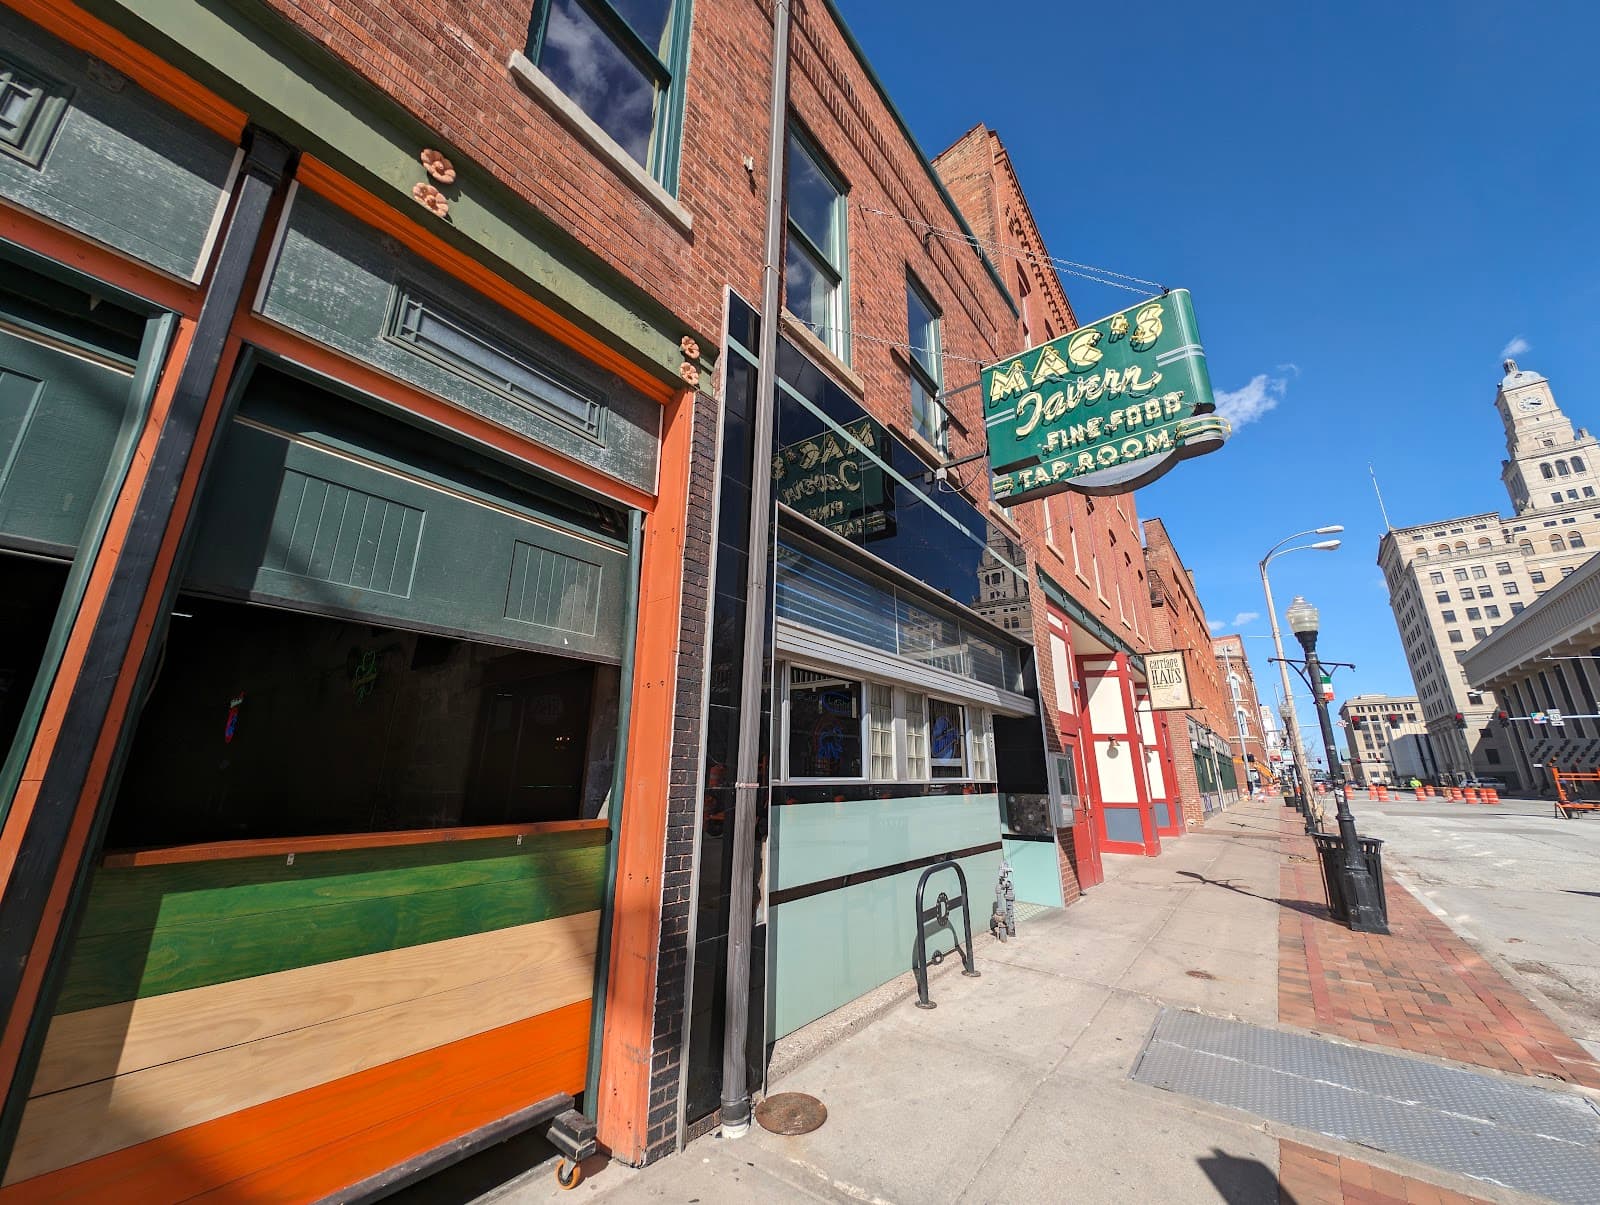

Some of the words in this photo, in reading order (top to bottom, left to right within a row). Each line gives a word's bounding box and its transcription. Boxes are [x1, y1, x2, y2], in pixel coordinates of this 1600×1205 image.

[990, 303, 1164, 402] MAC'S
[1015, 365, 1162, 436] Tavern
[1046, 417, 1103, 450] FINE
[1108, 391, 1183, 430] FOOD
[1018, 461, 1068, 488] TAP
[1078, 430, 1171, 472] ROOM
[1151, 668, 1182, 685] HAUS
